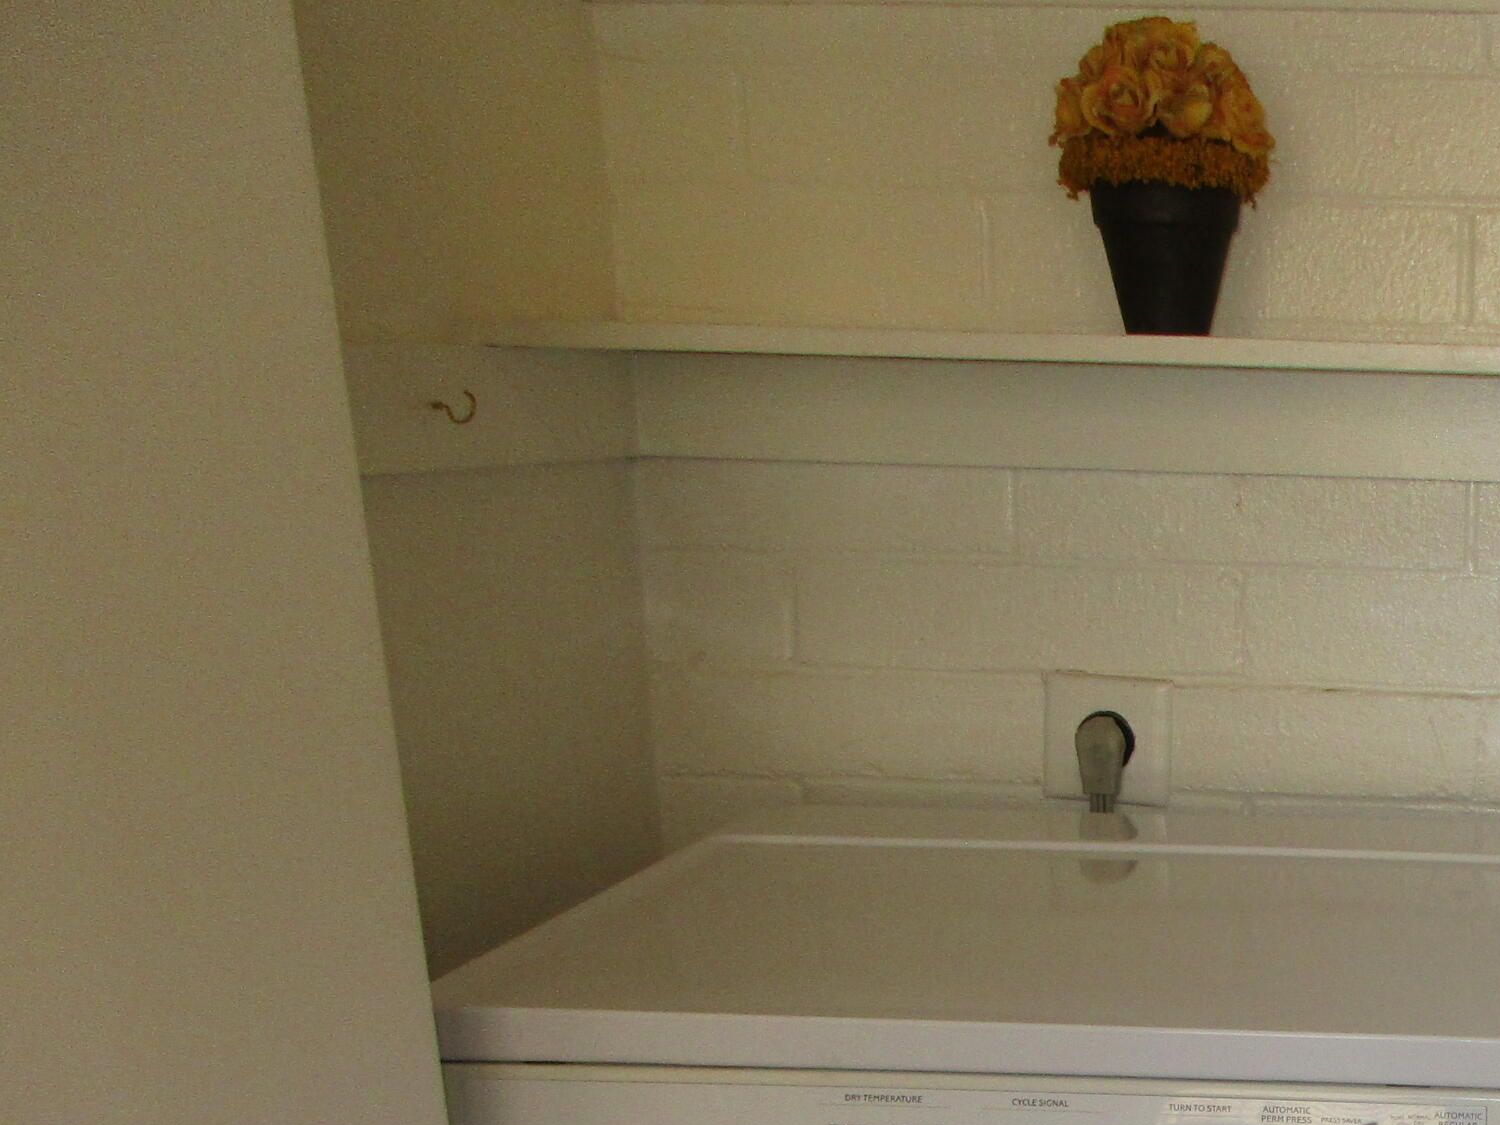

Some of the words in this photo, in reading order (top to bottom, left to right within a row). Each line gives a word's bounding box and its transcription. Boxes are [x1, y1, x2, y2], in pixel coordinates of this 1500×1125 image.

[845, 1094, 861, 1102] DRY
[863, 1094, 922, 1103] TEMPERATURE
[1011, 1098, 1037, 1107] CYCLE
[1038, 1099, 1070, 1108] SIGNAL
[1169, 1104, 1192, 1112] TURN
[1193, 1105, 1206, 1113] TO
[1206, 1105, 1232, 1113] START
[1263, 1106, 1311, 1115] AUTOMATIC
[1261, 1115, 1284, 1124] PERM
[1286, 1116, 1312, 1125] PRESS
[1434, 1111, 1482, 1120] AUTOMATIC
